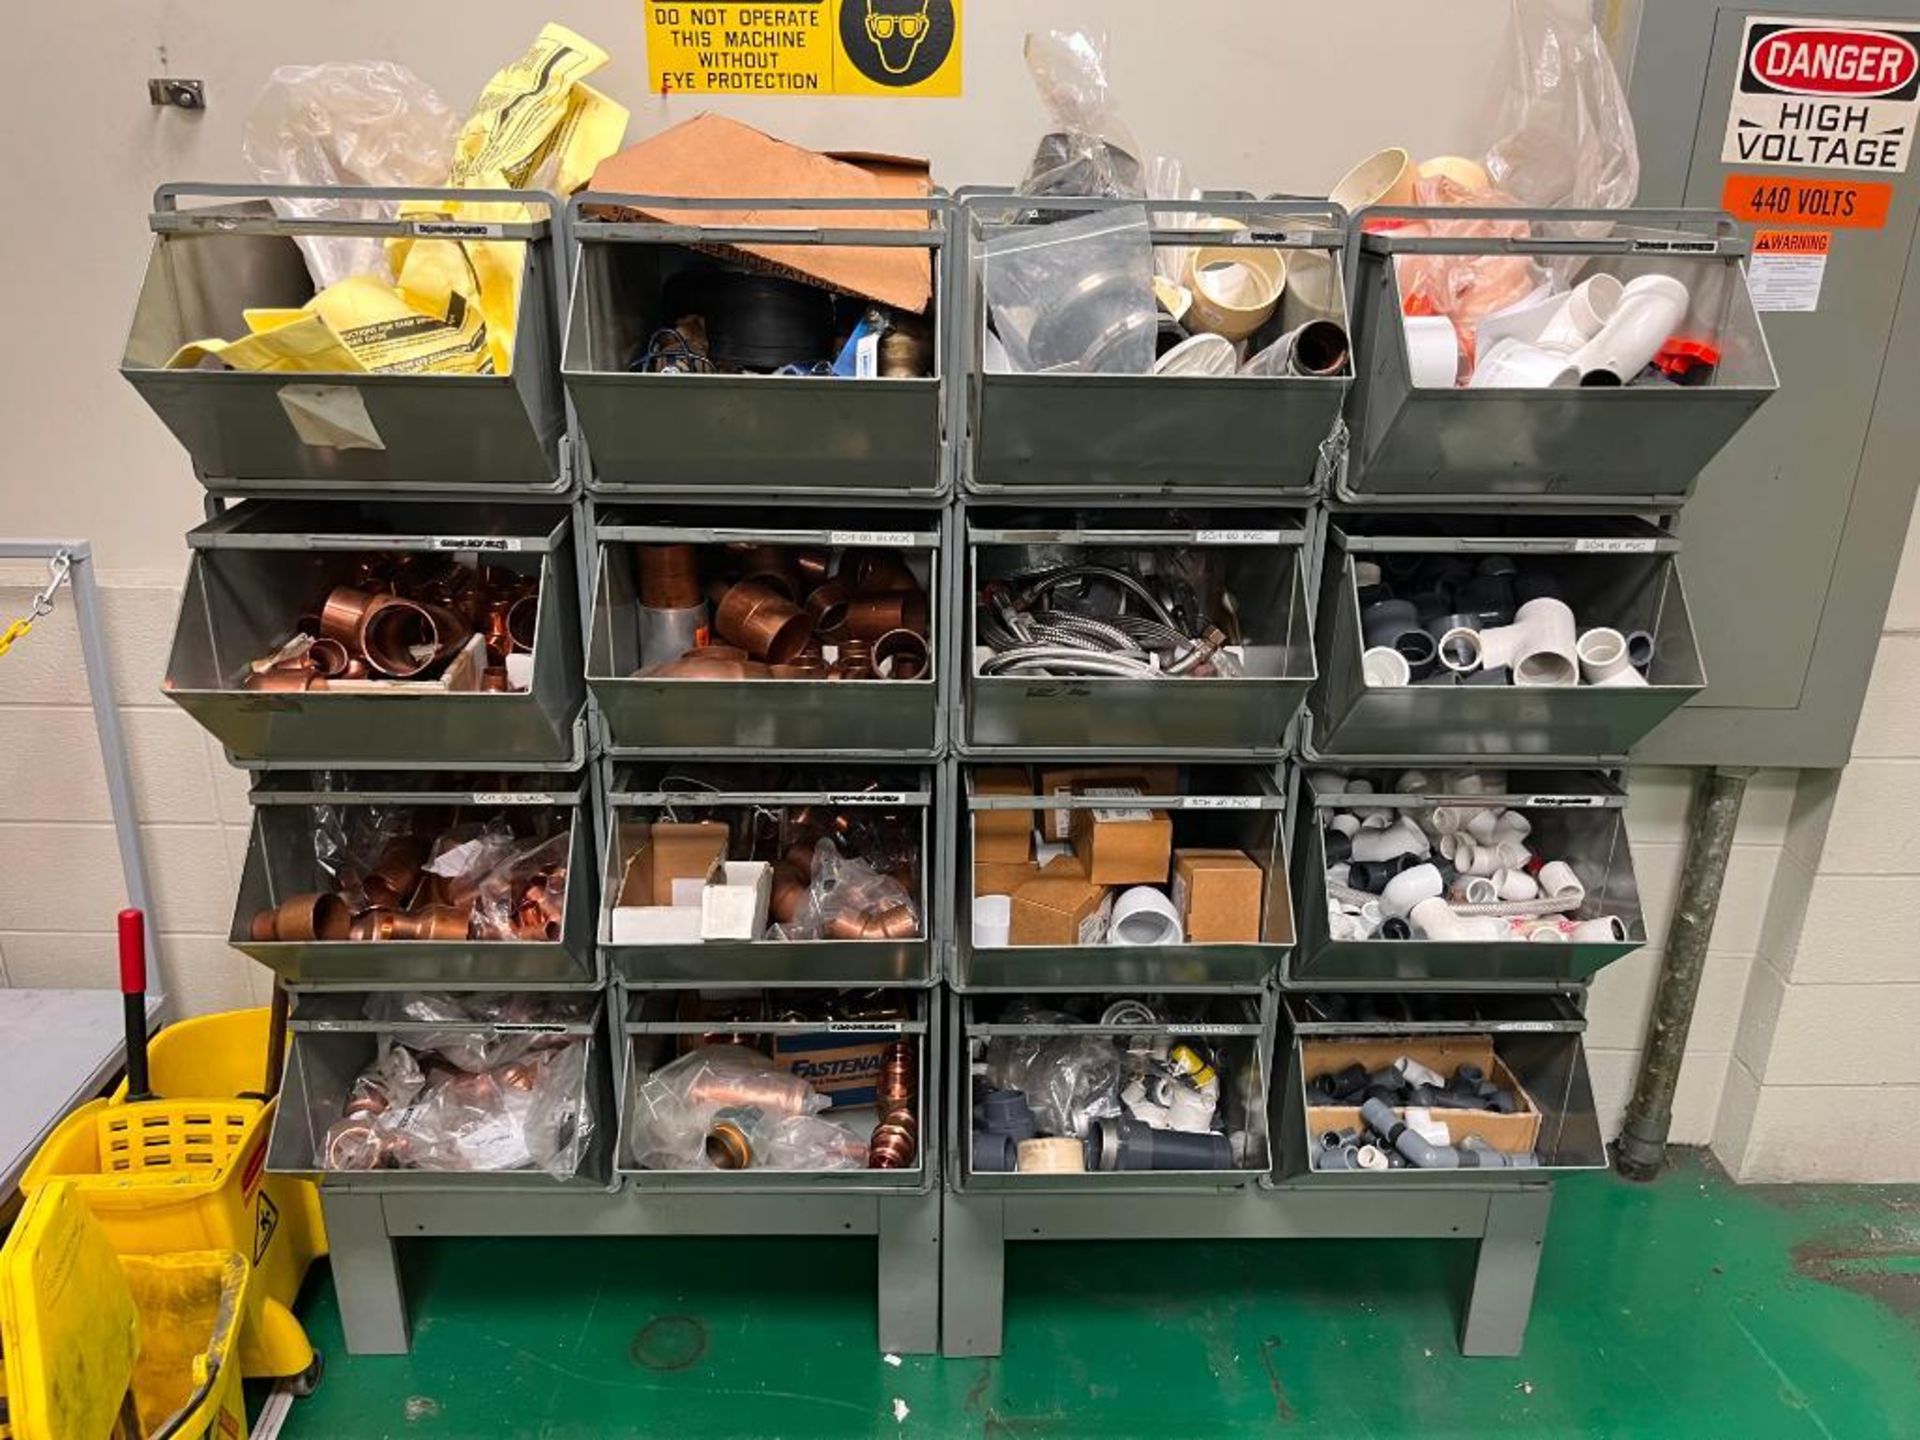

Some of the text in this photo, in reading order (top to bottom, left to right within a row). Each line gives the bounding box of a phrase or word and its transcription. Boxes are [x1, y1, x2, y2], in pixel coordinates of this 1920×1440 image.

[656, 9, 819, 27] DO NOT OPERATE
[671, 31, 805, 48] THIS MACHINE
[699, 52, 778, 69] WITHOUT
[1766, 41, 1903, 83] DANGER
[663, 72, 818, 90] EYE PROTECTION
[1779, 102, 1868, 133] HIGH
[1738, 132, 1900, 167] VOLTAGE
[1751, 186, 1857, 217] 440 VOLTS
[1771, 234, 1828, 251] WARNING
